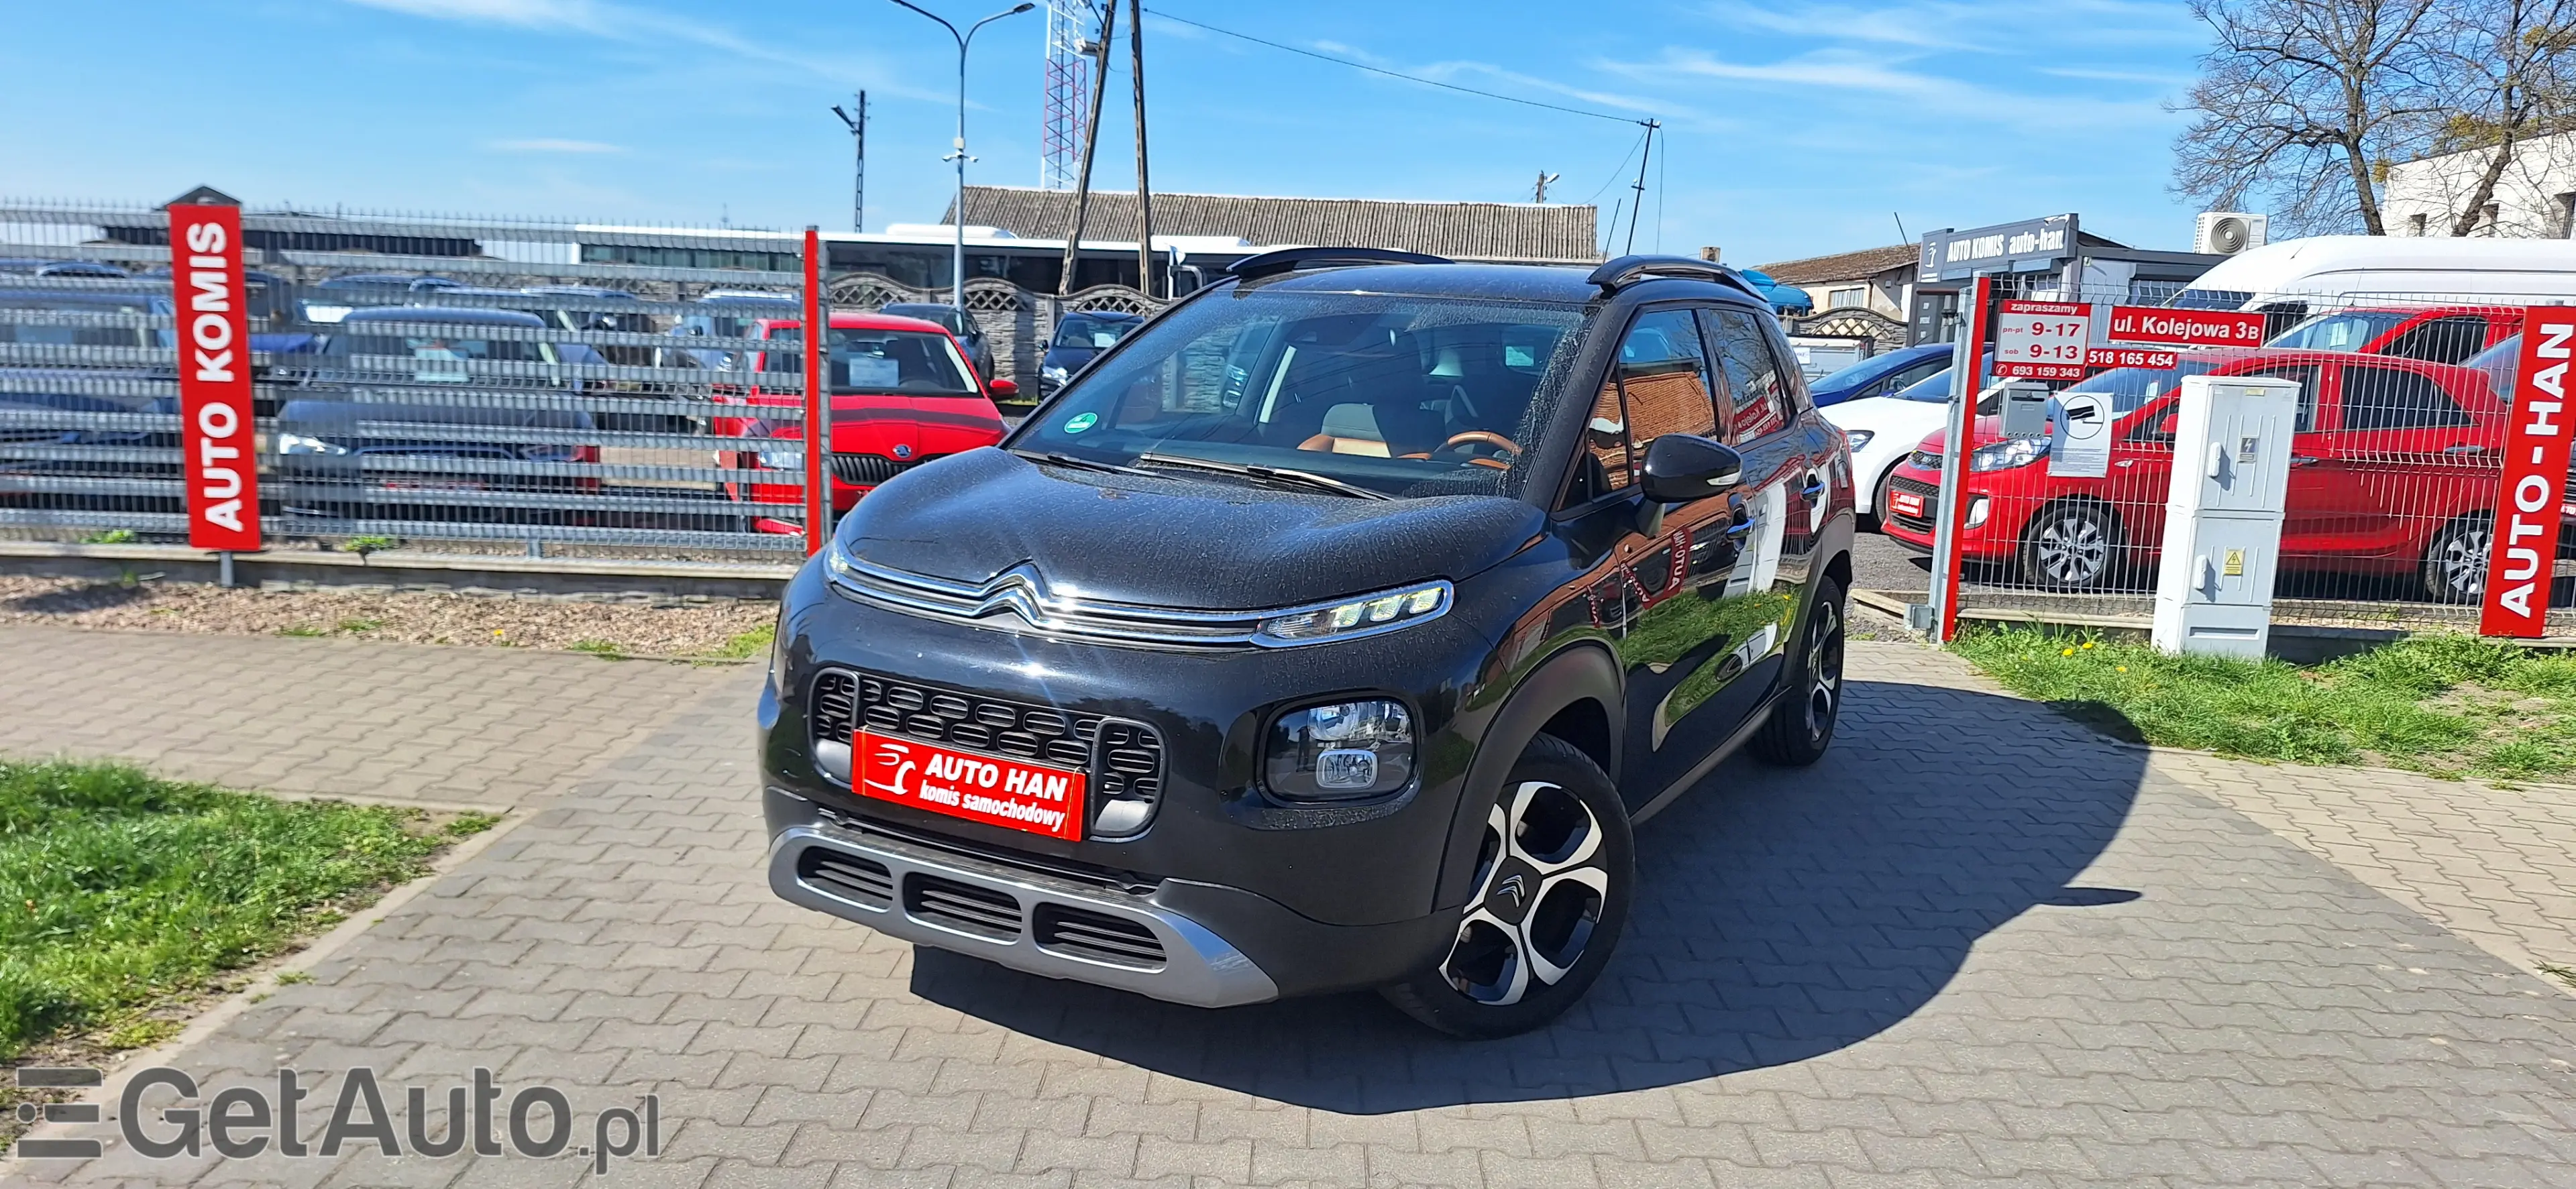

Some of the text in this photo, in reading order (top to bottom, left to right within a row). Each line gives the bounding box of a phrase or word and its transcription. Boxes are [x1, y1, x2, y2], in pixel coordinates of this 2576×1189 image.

[1947, 239, 1971, 262] AUTO
[1972, 234, 2004, 259] KOMIS
[2011, 304, 2078, 314] zapraszamy
[2031, 322, 2080, 337] 9-17
[2114, 316, 2259, 340] ul. Kolejowa 3B
[2029, 344, 2078, 359] 9-13
[2088, 351, 2174, 366] 518 165 454
[186, 222, 244, 532] AUTO KOMIS
[2012, 365, 2080, 378] 693 159 343
[925, 754, 1068, 801] AUTO HAN
[919, 779, 1066, 832] komis samochodowy
